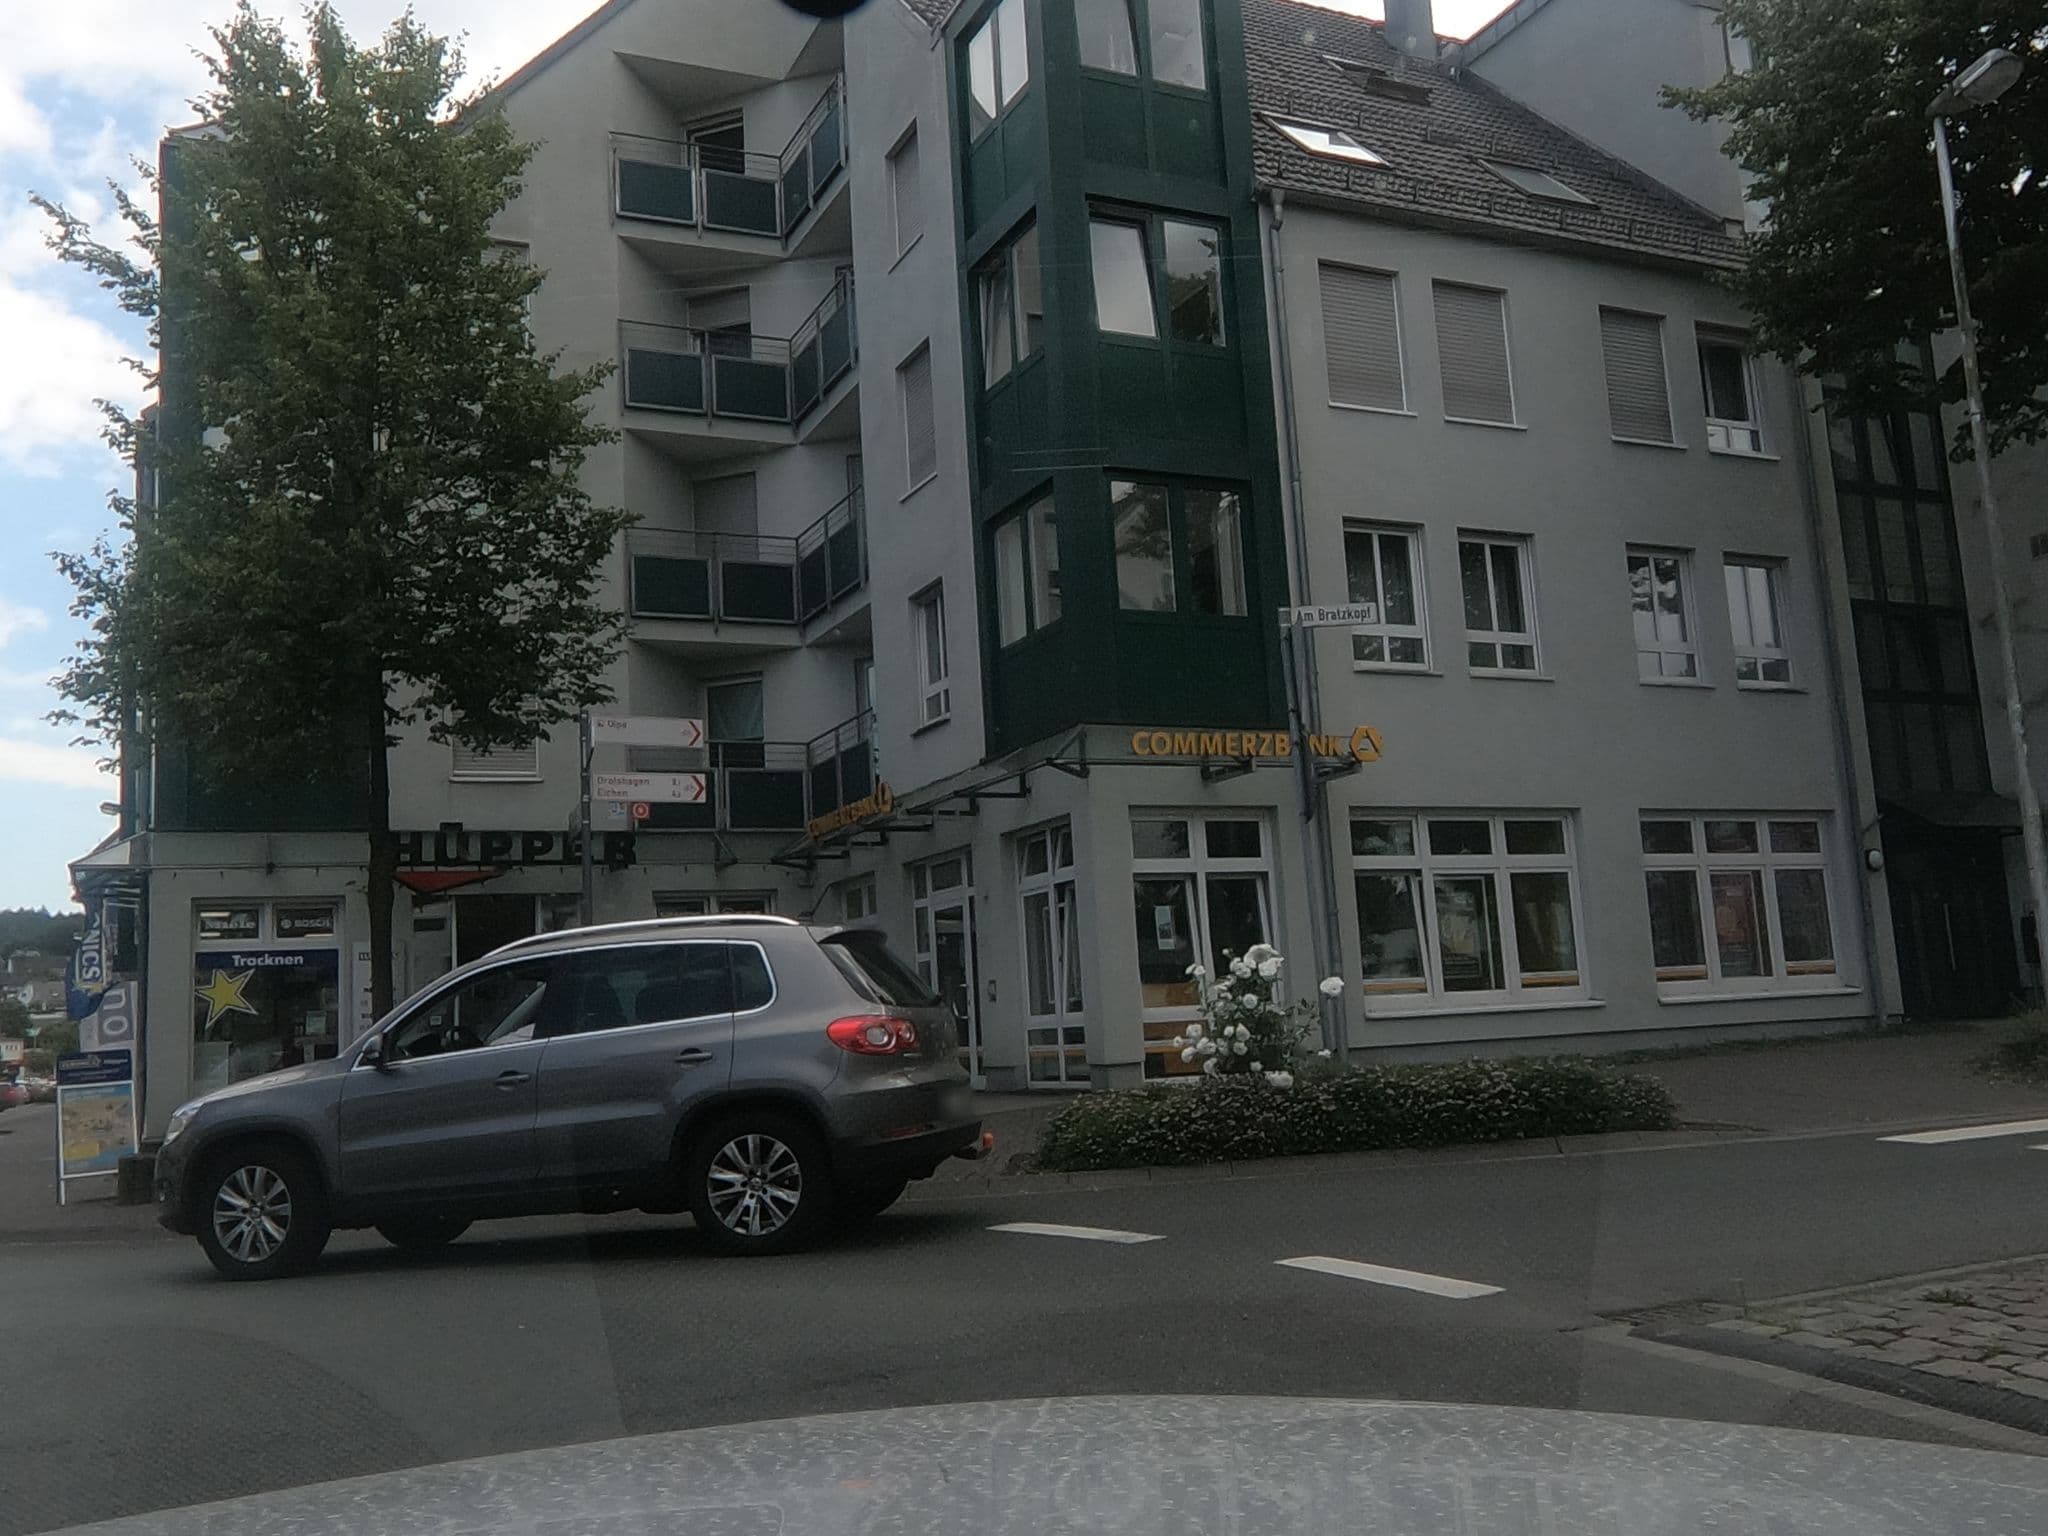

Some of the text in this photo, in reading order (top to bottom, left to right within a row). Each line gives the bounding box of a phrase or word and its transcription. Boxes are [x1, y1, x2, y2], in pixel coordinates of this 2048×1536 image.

[1296, 606, 1371, 623] Am Bratzkopf
[1131, 731, 1343, 757] COMMERZBNK
[231, 953, 304, 967] Trocknen
